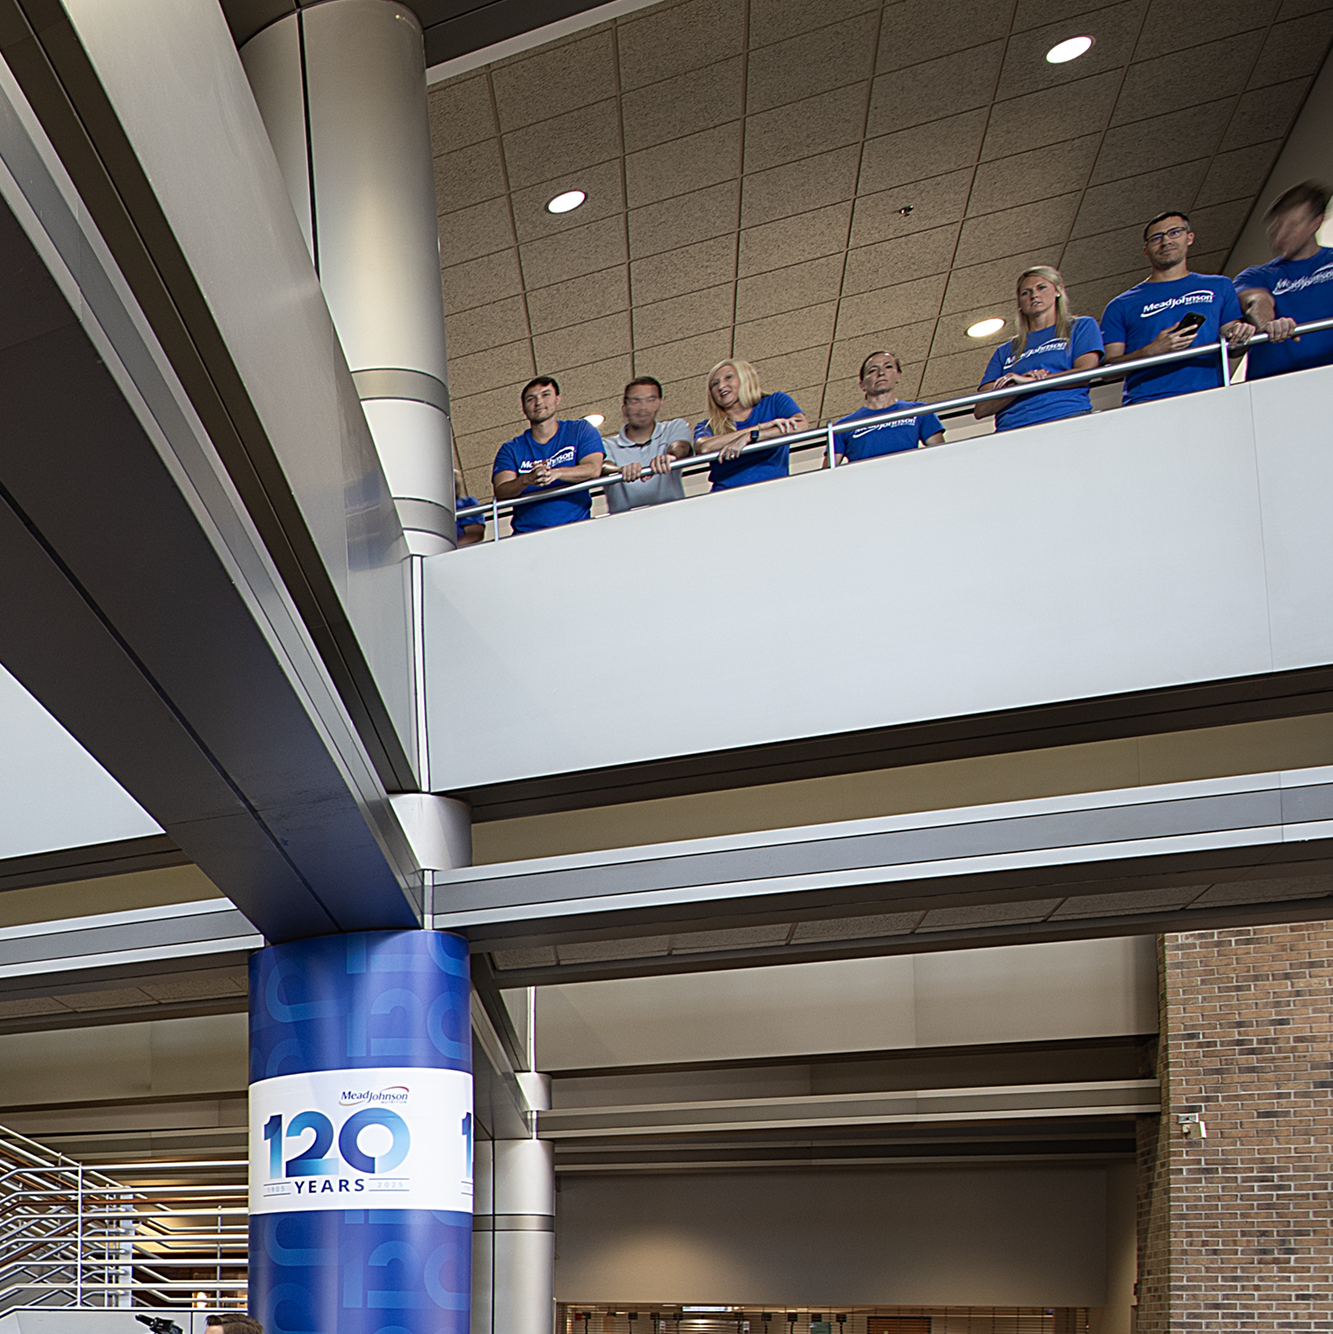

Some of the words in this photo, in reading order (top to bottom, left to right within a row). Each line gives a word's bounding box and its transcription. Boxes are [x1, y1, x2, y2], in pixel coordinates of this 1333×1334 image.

[1143, 294, 1213, 314] MeadJohnson
[341, 1090, 408, 1104] MeadJohnson
[264, 1107, 411, 1180] 120
[294, 1178, 365, 1195] YEARS
